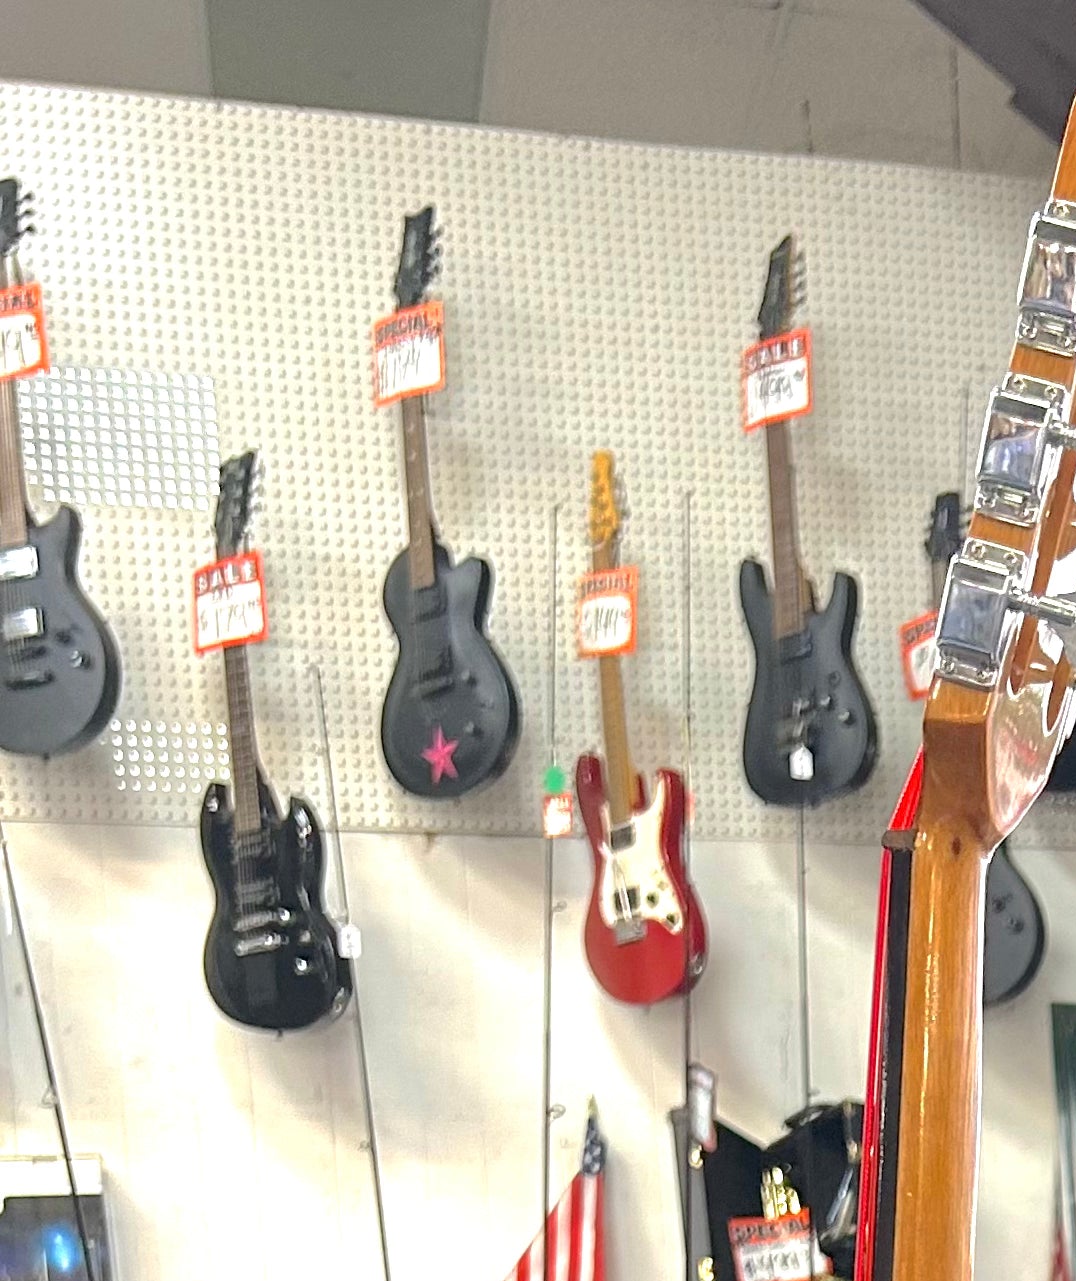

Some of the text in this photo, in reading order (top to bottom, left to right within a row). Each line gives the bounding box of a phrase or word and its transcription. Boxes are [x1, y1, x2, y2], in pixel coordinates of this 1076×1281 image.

[375, 311, 429, 344] SPECIAL
[746, 338, 804, 371] SALE
[196, 560, 257, 593] SALE
